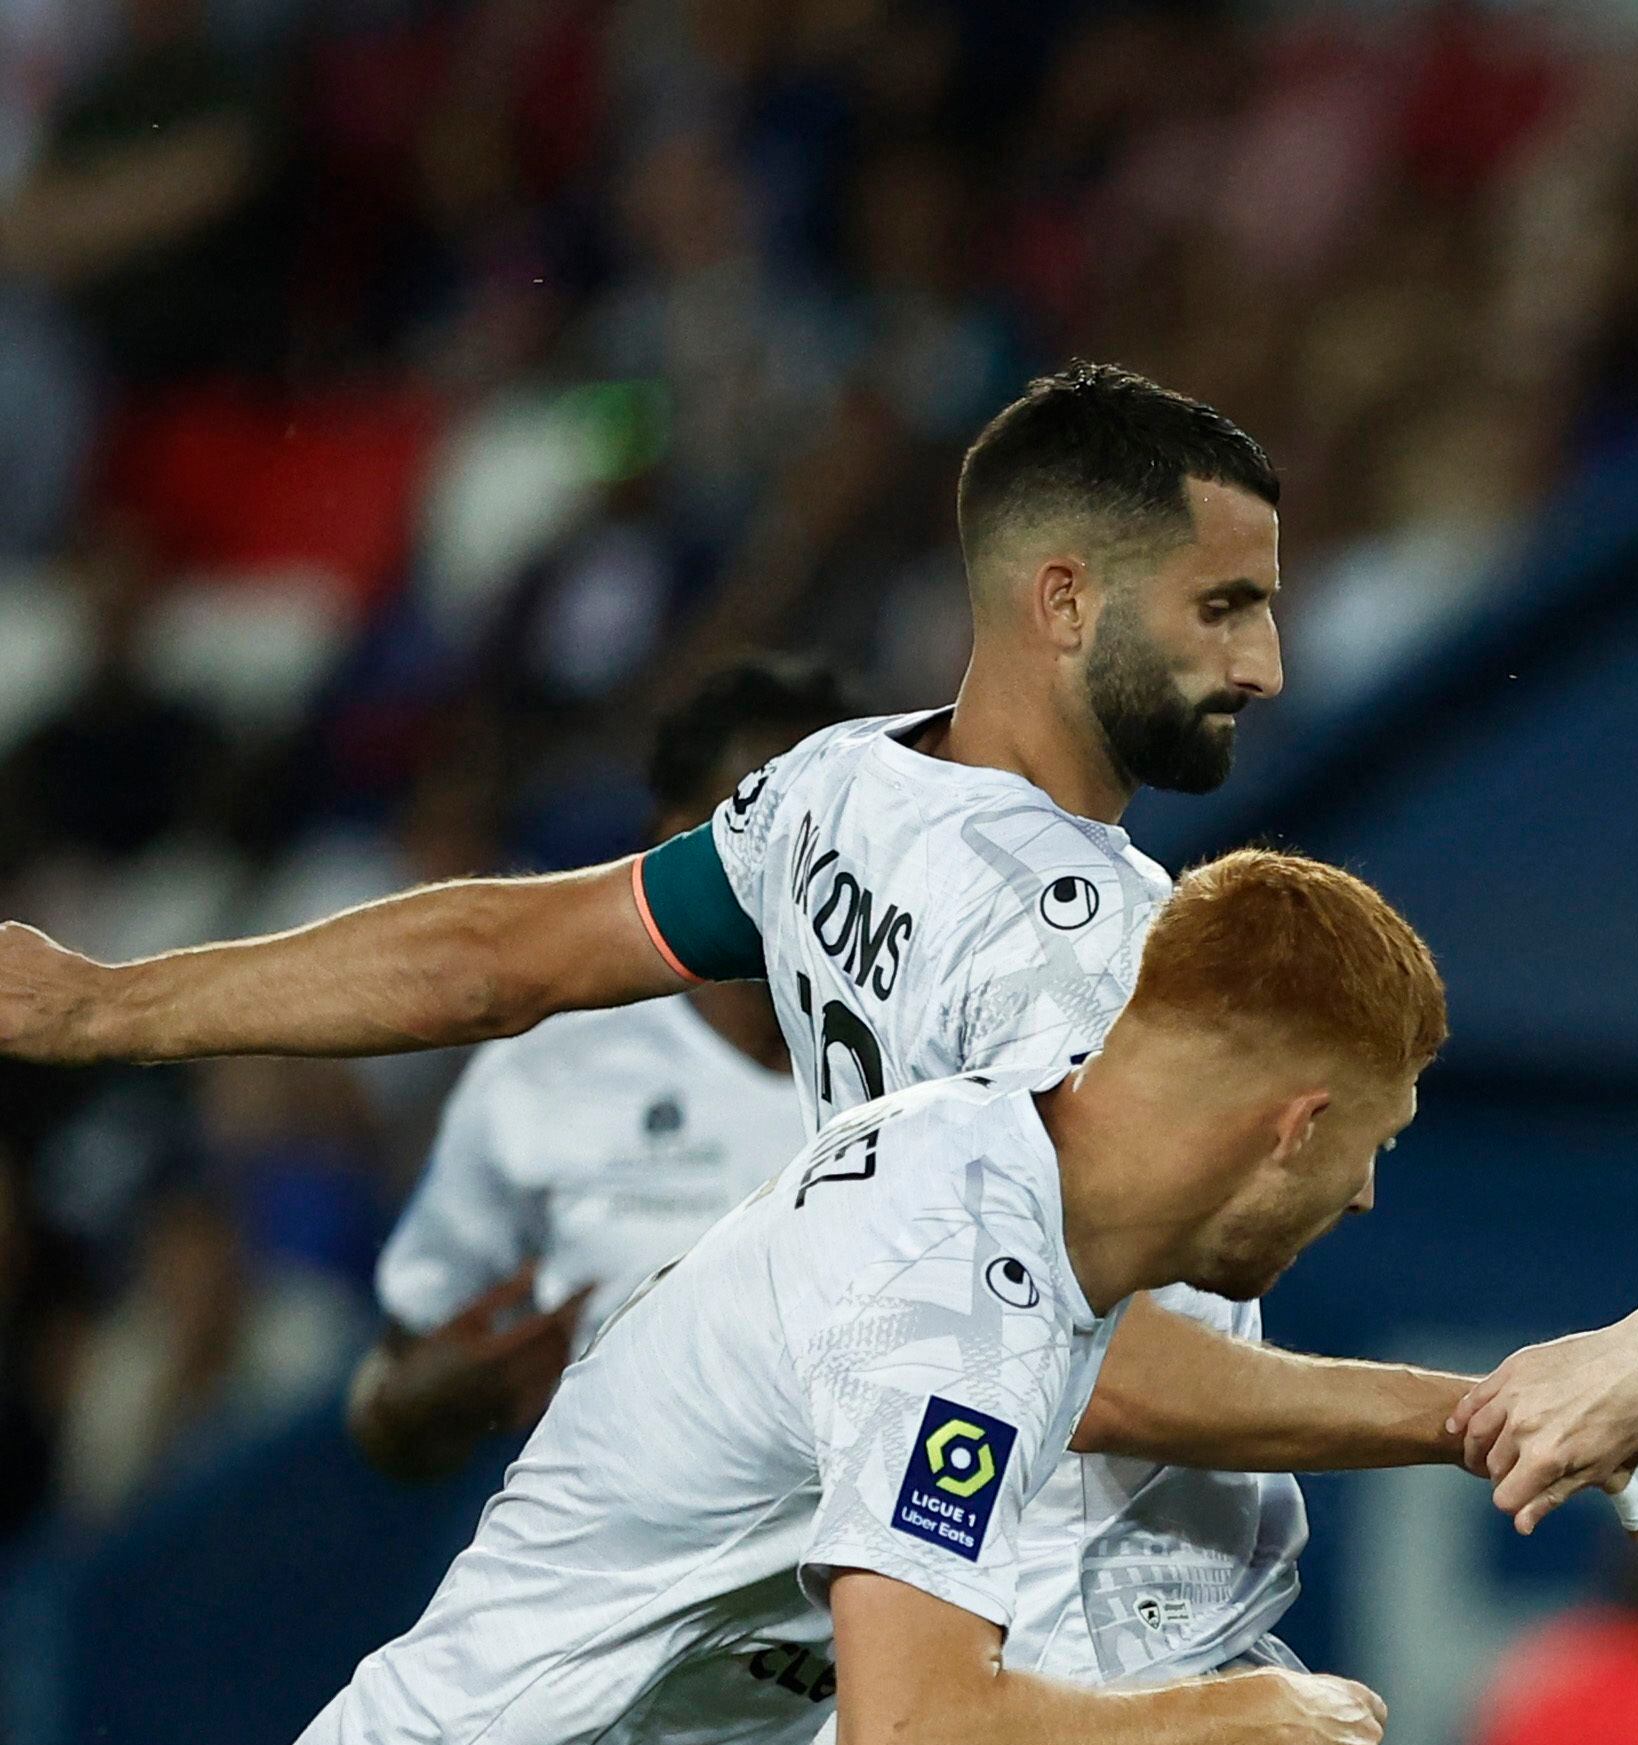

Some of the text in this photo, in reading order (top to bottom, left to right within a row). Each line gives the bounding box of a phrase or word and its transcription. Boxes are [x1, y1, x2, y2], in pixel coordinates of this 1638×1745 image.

[901, 1506, 975, 1548] Uber Eats
[911, 1490, 977, 1528] LIGUE 1
